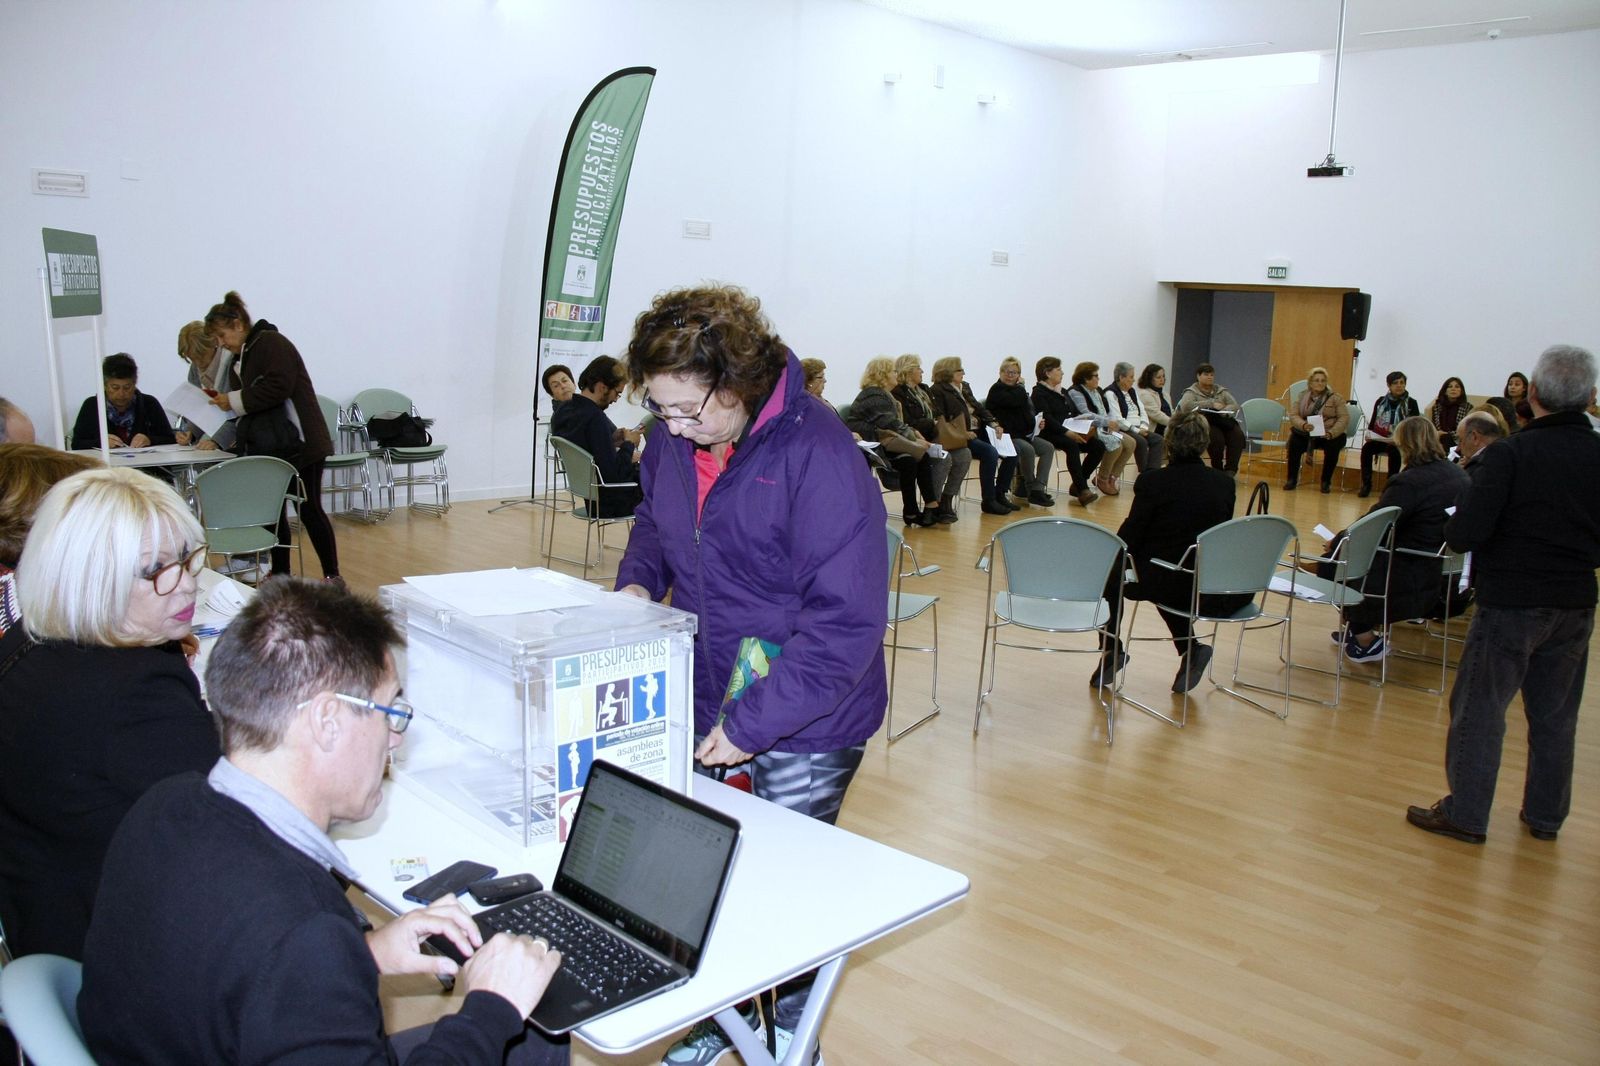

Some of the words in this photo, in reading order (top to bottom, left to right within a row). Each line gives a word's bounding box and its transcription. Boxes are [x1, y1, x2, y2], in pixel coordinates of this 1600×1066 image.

[568, 120, 608, 255] PRESUPUESTOS
[584, 125, 620, 257] PARTICIPATIVOS
[1268, 268, 1286, 277] SALIDA
[582, 640, 666, 672] PRESUPUESTOS
[617, 738, 664, 756] asambleas
[630, 752, 641, 762] de
[643, 749, 664, 760] zona
